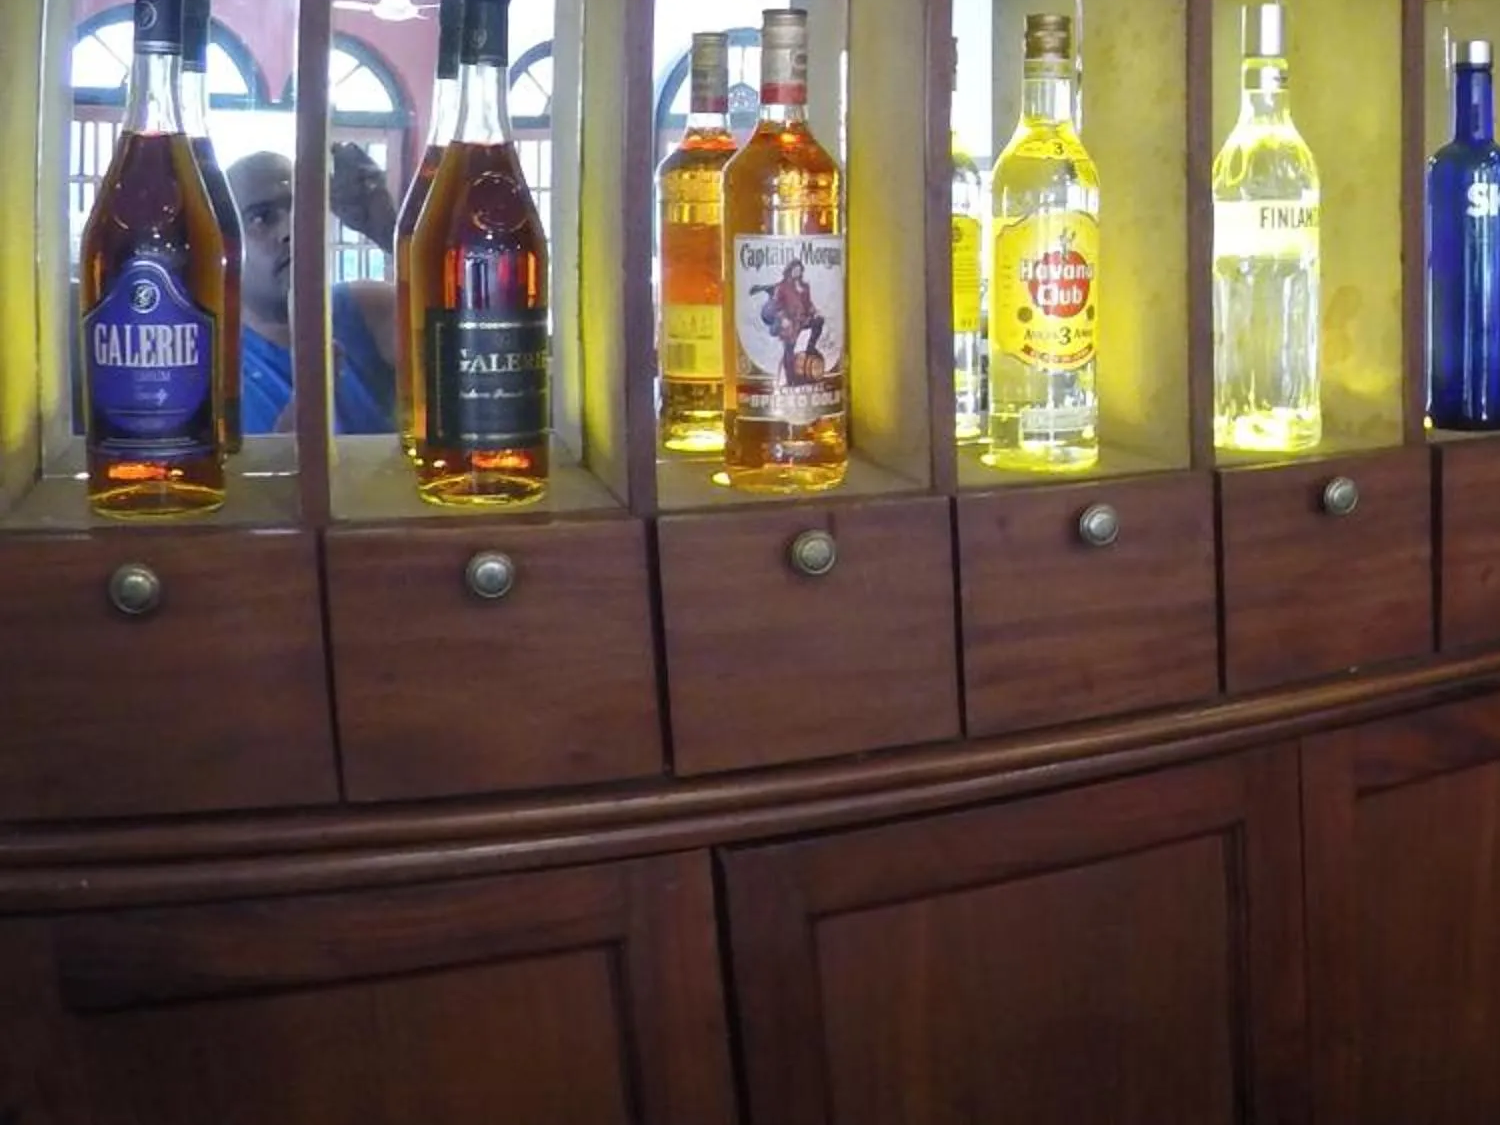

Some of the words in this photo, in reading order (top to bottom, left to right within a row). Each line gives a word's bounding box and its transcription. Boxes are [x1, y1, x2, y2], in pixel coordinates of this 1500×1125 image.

[740, 241, 795, 271] Captain
[1036, 282, 1084, 306] Club
[94, 323, 199, 367] GALERIE
[1059, 326, 1072, 346] 3
